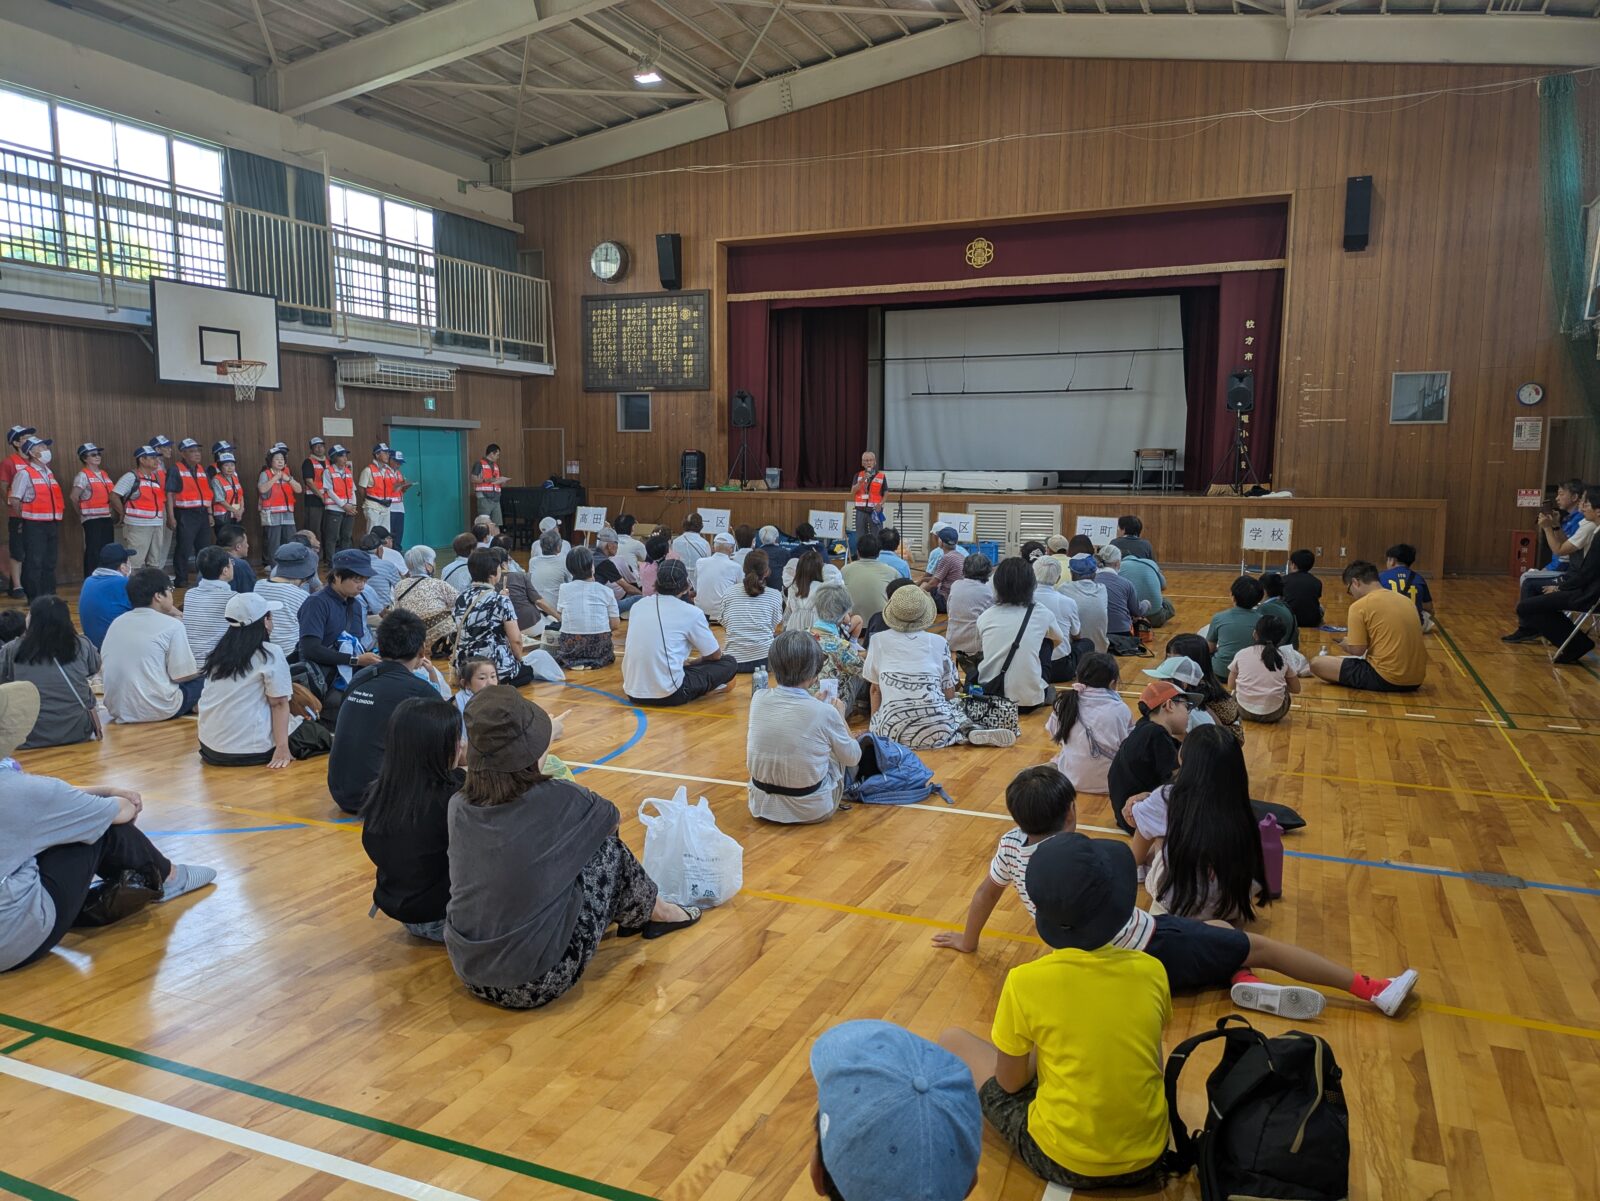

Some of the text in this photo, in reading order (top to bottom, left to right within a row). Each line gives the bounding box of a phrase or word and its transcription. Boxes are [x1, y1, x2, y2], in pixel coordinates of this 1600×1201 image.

[580, 513, 602, 524] 高田
[814, 518, 838, 531] 京阪
[1082, 524, 1112, 538] 元町
[1249, 527, 1284, 542] 学校
